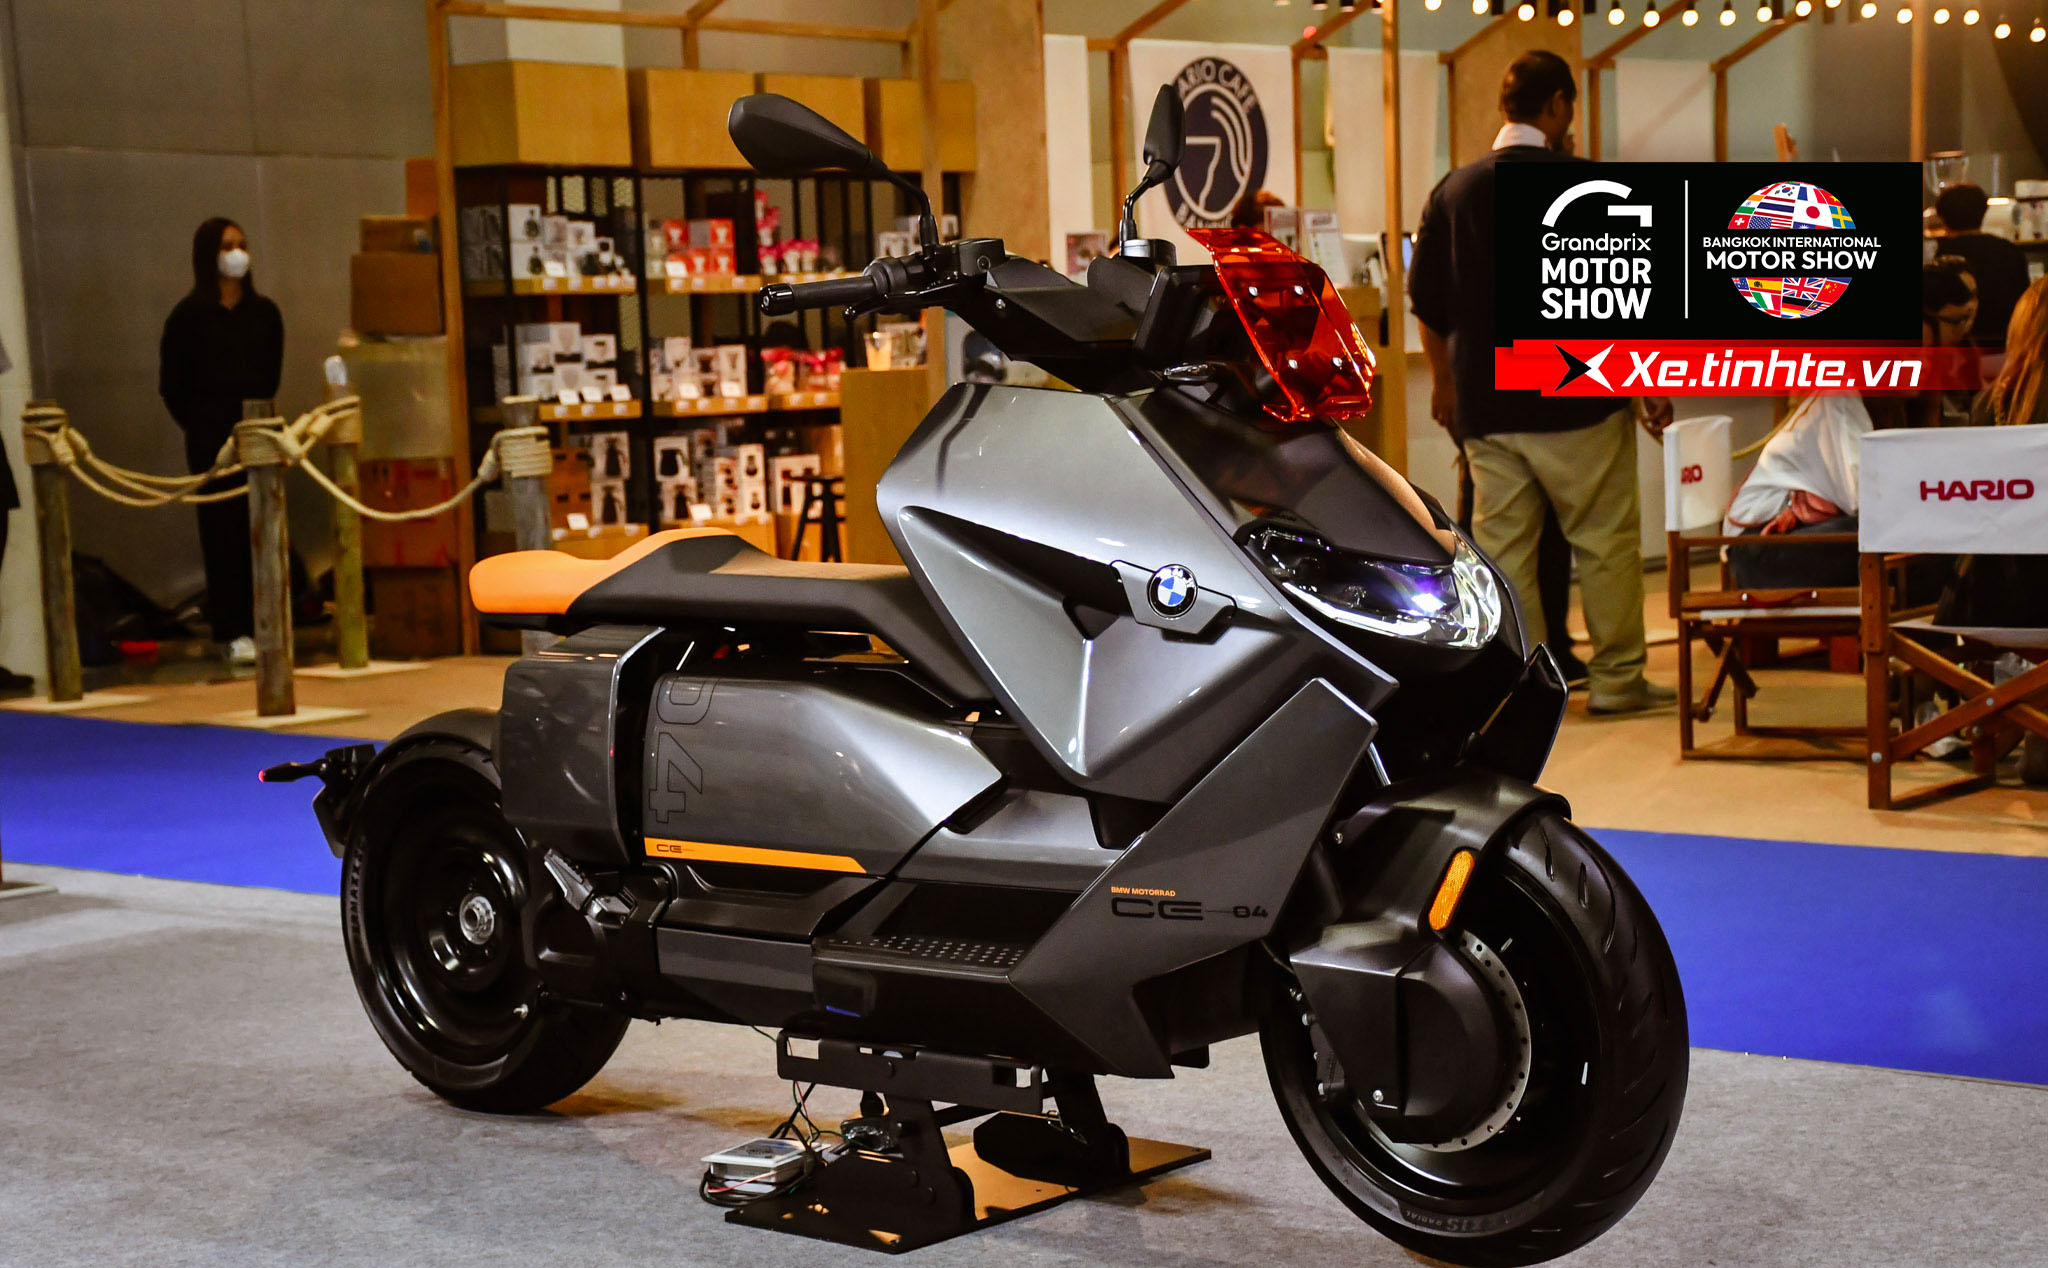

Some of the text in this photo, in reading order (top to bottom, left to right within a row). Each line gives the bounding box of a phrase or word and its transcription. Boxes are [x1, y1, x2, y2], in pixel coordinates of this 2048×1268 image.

[1920, 479, 2034, 501] HARIO
[1111, 886, 1176, 897] BMW MOTORRAD
